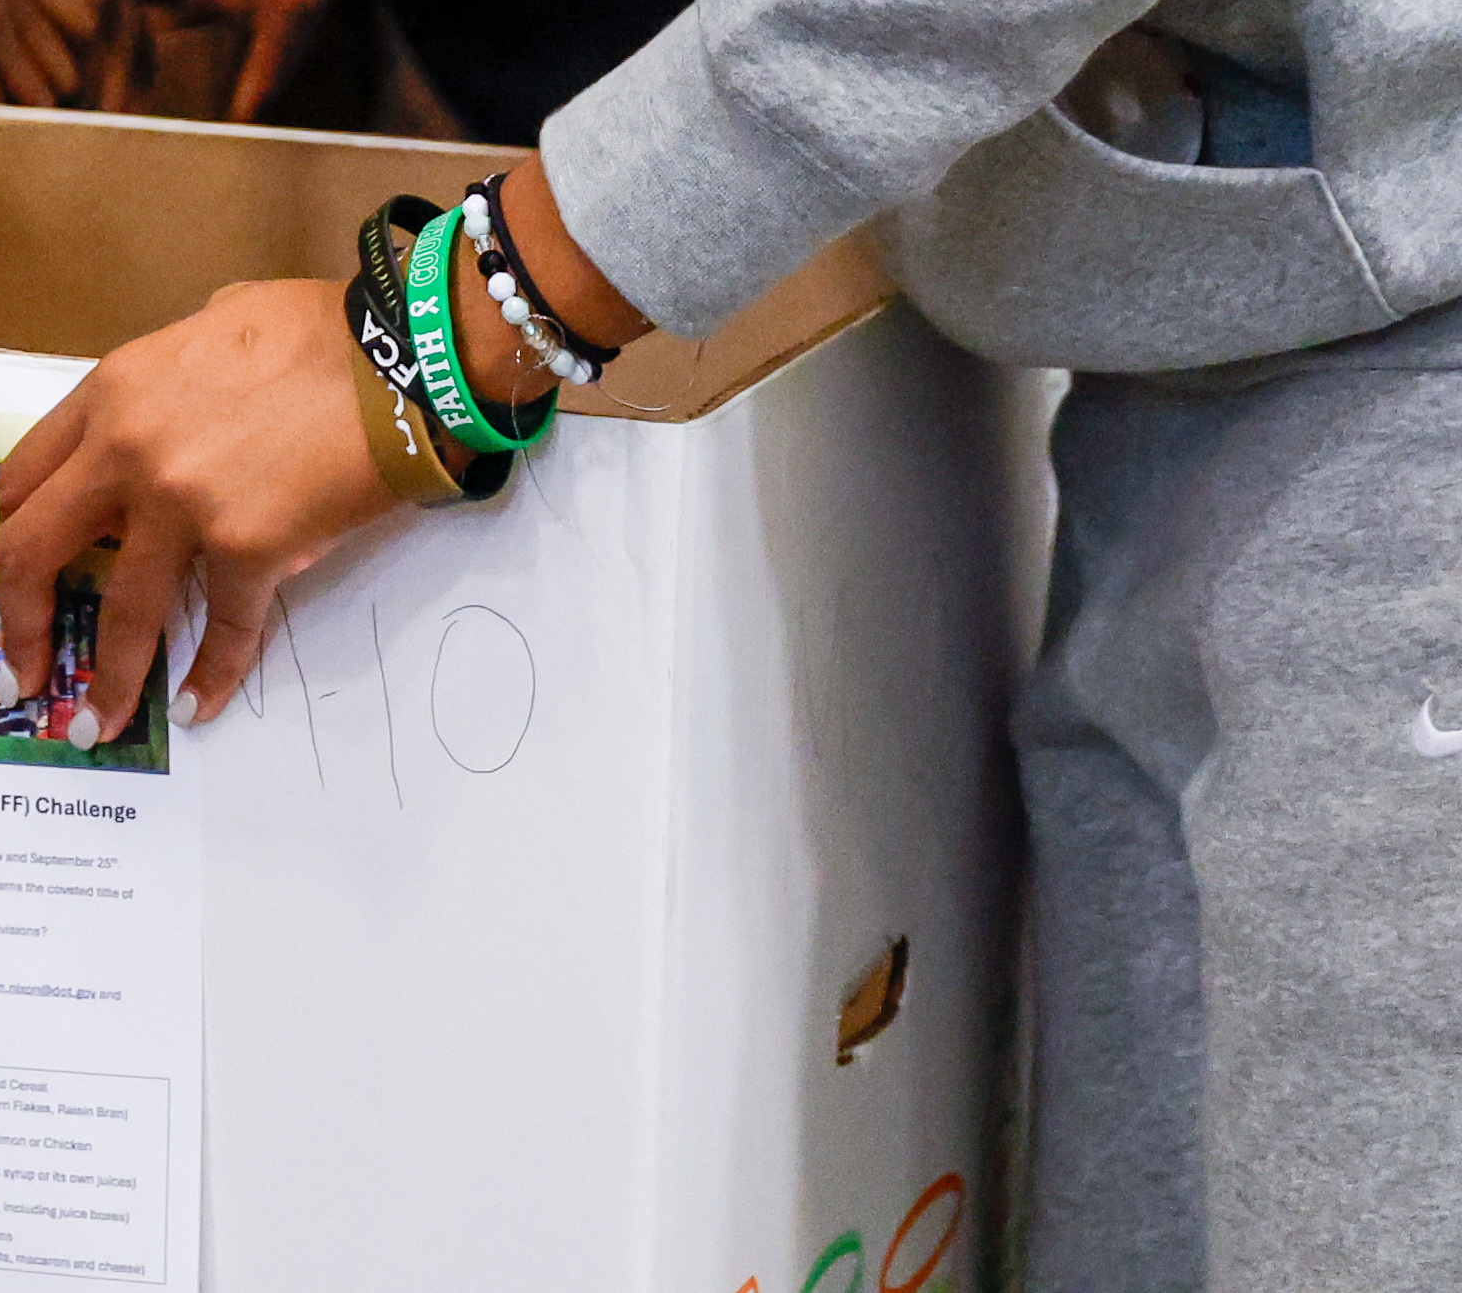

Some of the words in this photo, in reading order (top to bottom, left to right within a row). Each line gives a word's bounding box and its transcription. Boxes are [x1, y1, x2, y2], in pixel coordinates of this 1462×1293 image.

[360, 308, 420, 388] FCA
[413, 326, 474, 431] FAITH
[36, 797, 136, 823] Challenge
